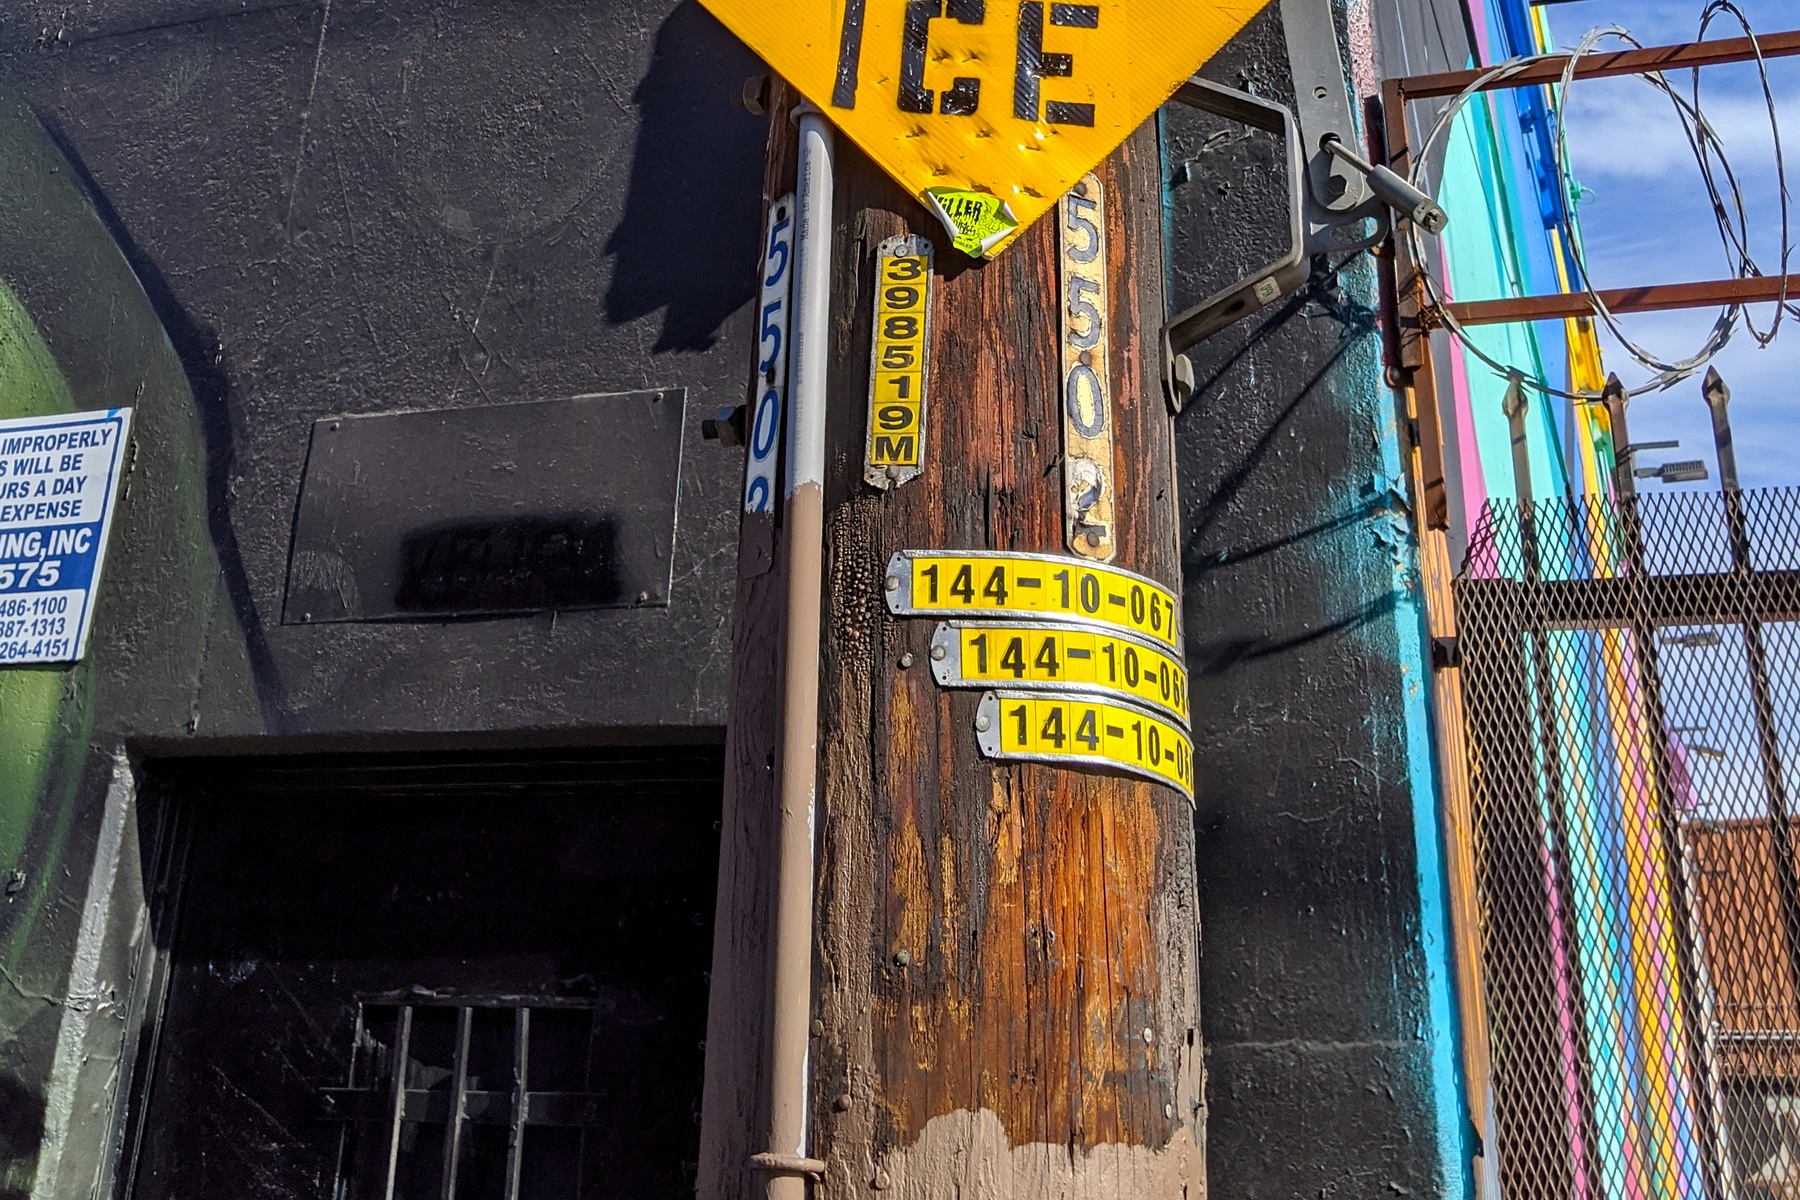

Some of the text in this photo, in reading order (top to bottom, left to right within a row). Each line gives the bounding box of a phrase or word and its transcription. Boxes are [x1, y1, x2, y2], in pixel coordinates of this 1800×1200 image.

[874, 258, 922, 462] 398519M
[1, 428, 113, 456] IMPROPERLY
[13, 456, 54, 476] WILL
[59, 453, 84, 472] BE
[34, 480, 46, 497] A
[52, 475, 88, 496] DAY
[1, 499, 83, 522] EXPENSE
[920, 563, 1174, 641] 144-10-067
